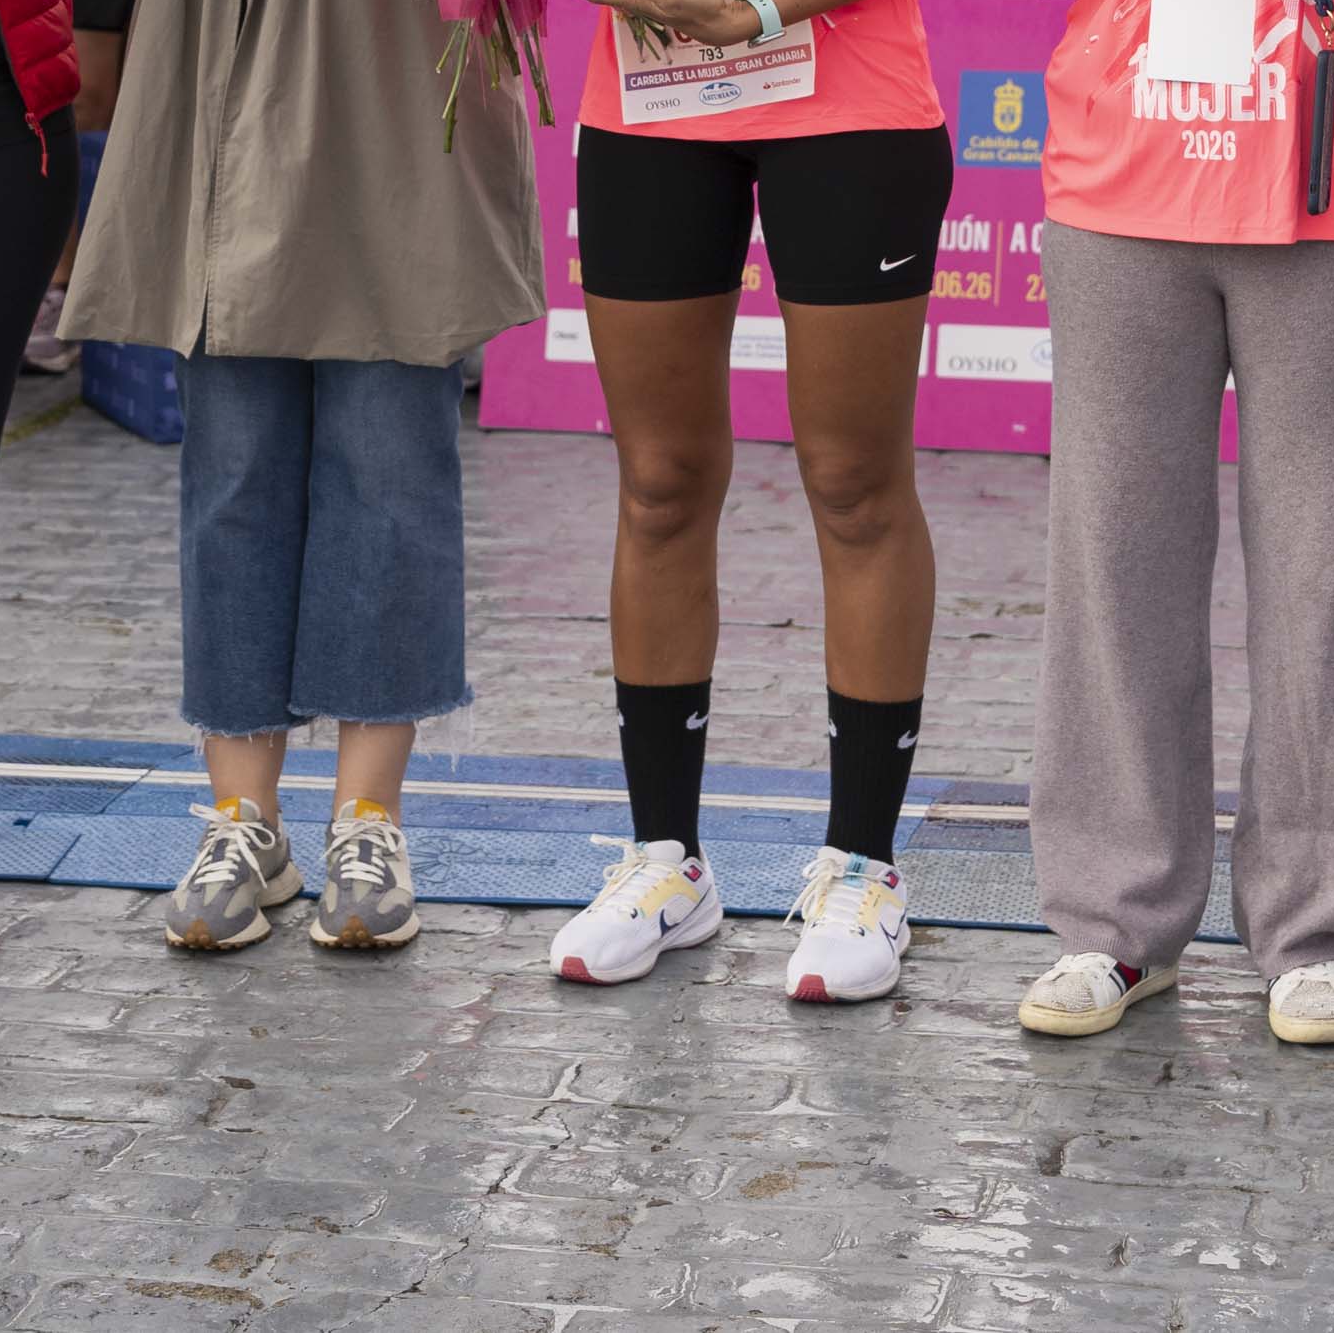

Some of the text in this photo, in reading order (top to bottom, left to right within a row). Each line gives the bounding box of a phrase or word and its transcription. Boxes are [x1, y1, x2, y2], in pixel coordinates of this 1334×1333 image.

[699, 46, 724, 62] 793
[630, 49, 807, 88] CARRERA DE LA MUJER GRAN CANARIA
[701, 89, 739, 102] ASTURIANA
[1131, 62, 1287, 122] MUJER
[645, 98, 681, 111] OYSHO
[969, 135, 1039, 150] Cabildo de
[1181, 130, 1237, 161] 2026
[962, 148, 995, 162] Gran
[947, 355, 1018, 374] OYSHO
